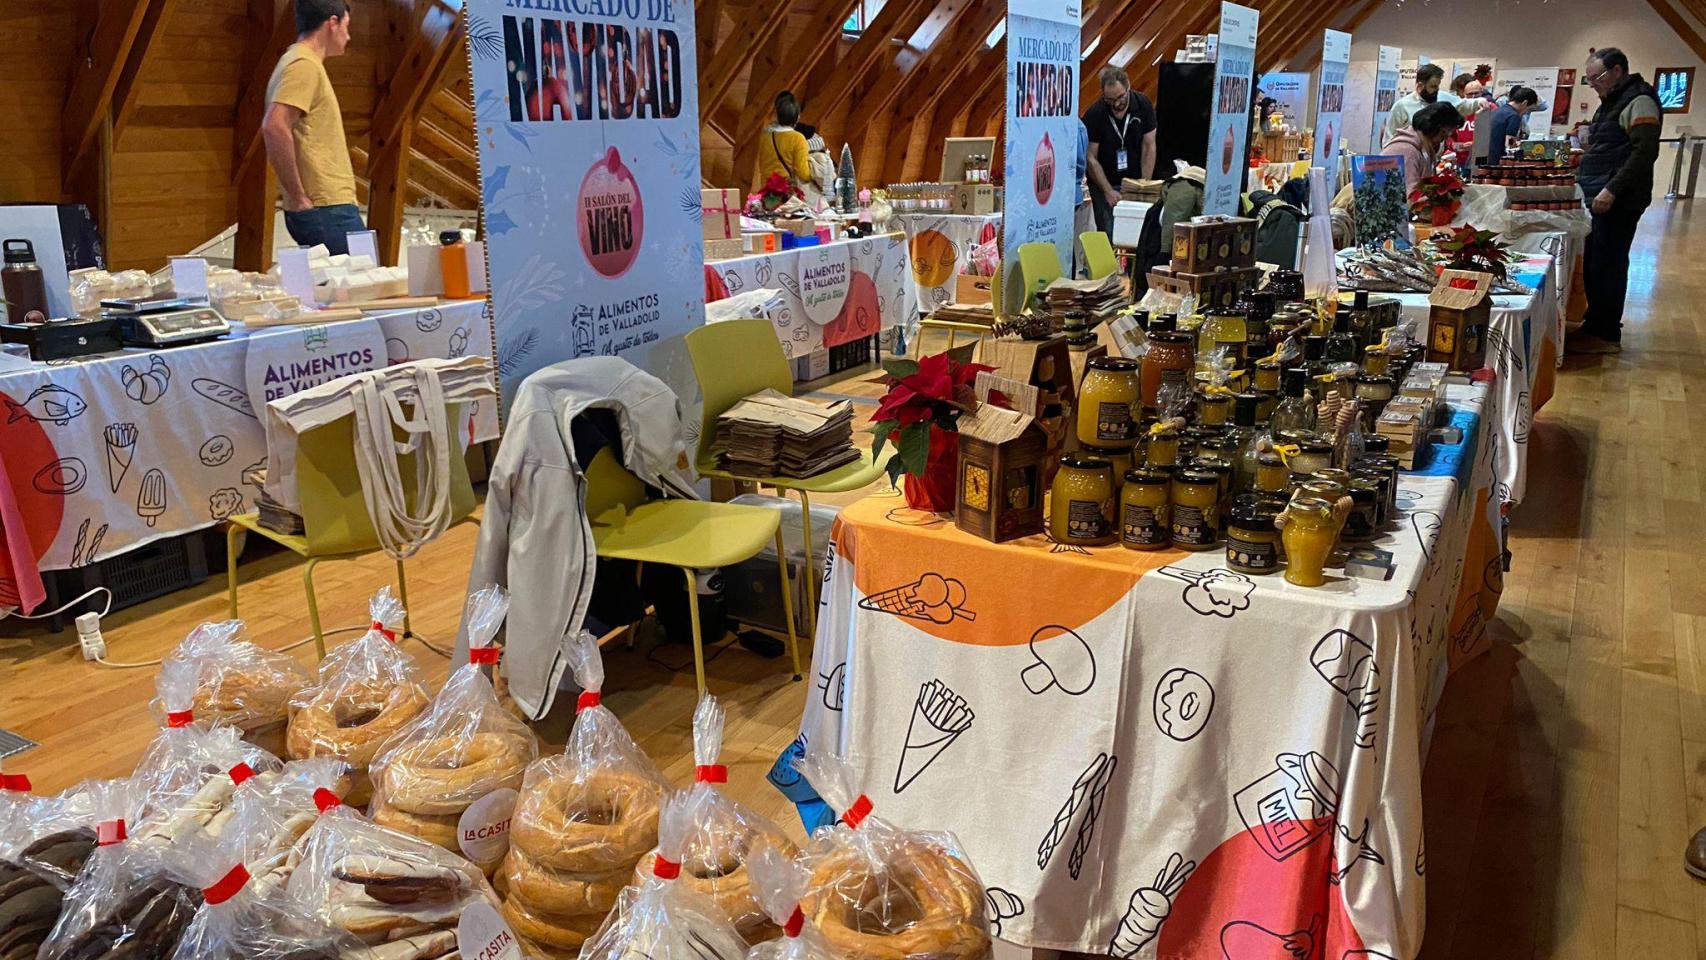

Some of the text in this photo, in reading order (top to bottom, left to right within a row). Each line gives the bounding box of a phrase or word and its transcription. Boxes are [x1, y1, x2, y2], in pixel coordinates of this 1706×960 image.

[647, 0, 675, 23] DE
[1018, 37, 1073, 62] MERCADO DE
[502, 15, 682, 122] NAVIDAD
[1016, 61, 1073, 118] NAVIDAD
[592, 192, 616, 207] SALÓN
[617, 193, 631, 204] DEL
[586, 205, 633, 256] VINO
[803, 262, 845, 280] ALIMENTOS
[804, 281, 812, 291] DE
[598, 293, 659, 321] ALIMENTOS
[600, 310, 660, 336] DE VALLADOLID
[613, 336, 633, 357] gusto
[633, 334, 641, 347] de
[264, 348, 374, 386] ALIMENTOS
[265, 386, 285, 402] DE
[464, 816, 513, 841] LA CASIT
[1264, 798, 1297, 846] MIEL
